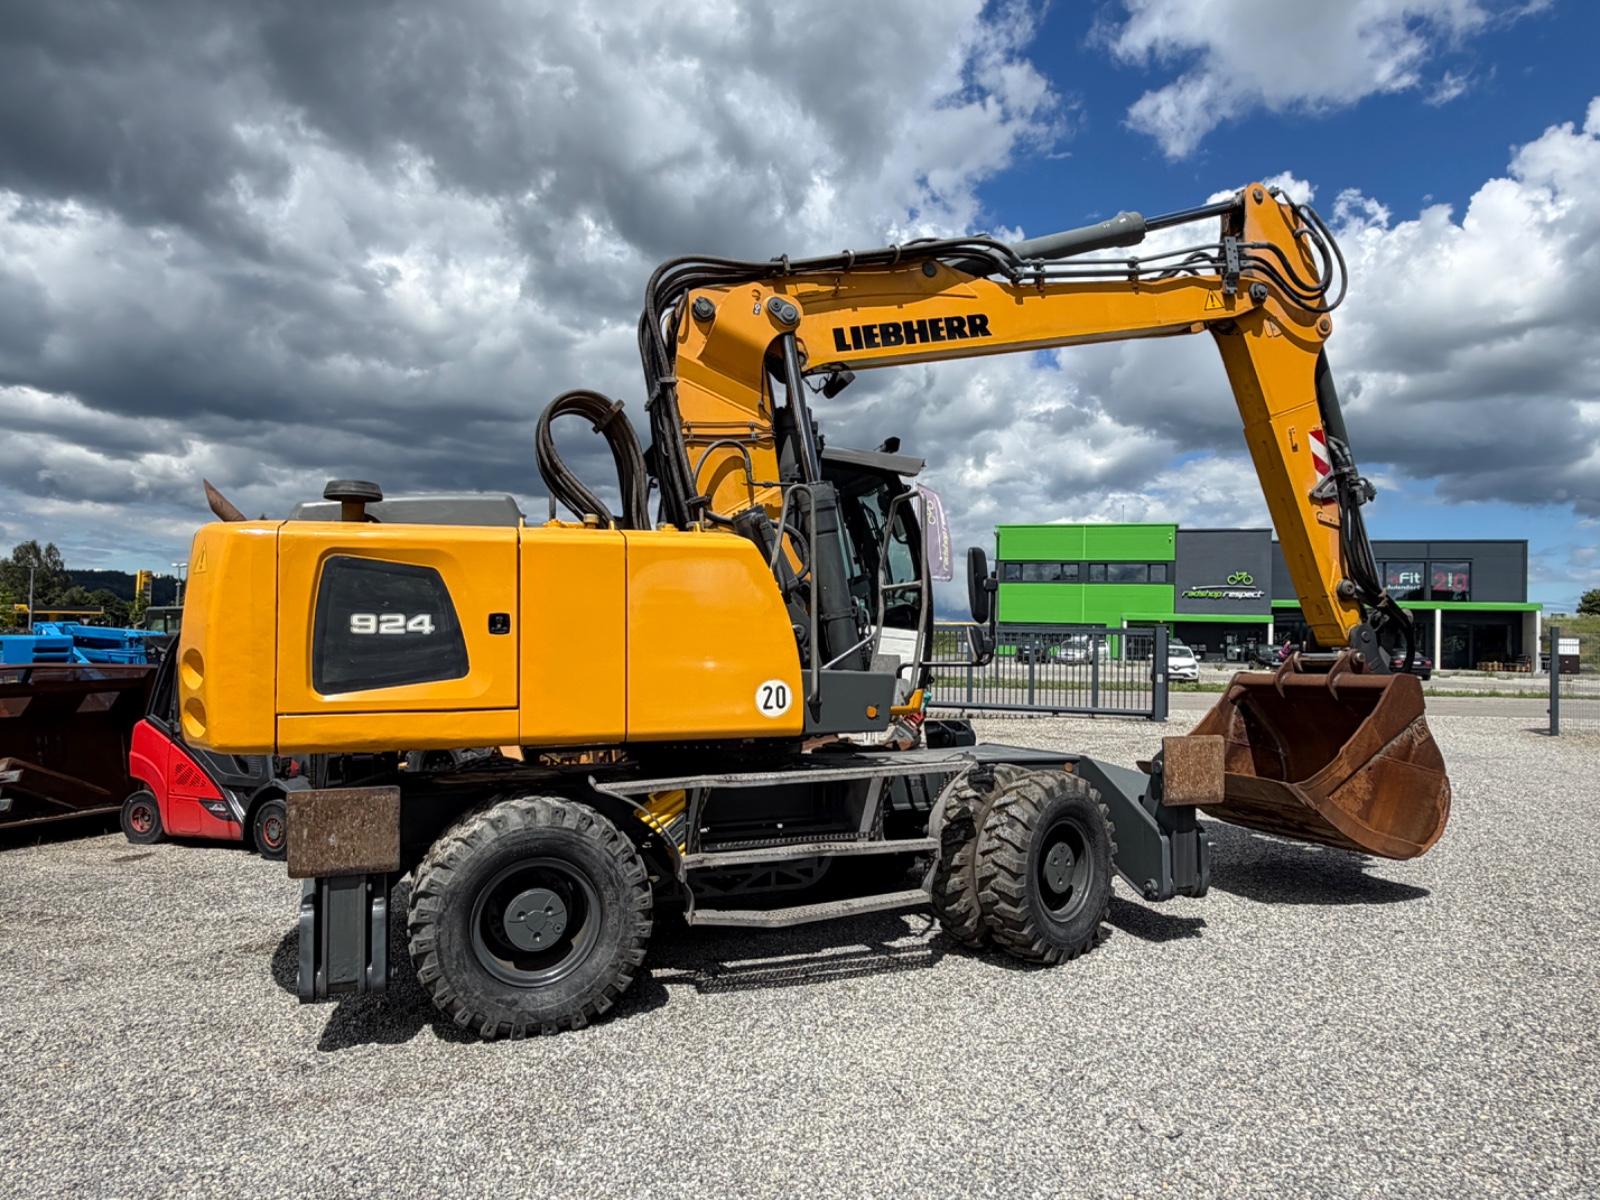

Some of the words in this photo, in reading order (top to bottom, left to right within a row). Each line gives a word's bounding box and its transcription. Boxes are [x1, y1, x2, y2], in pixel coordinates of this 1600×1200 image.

[832, 313, 992, 352] LIEBHERR
[350, 613, 435, 634] 924
[763, 685, 786, 709] 20
